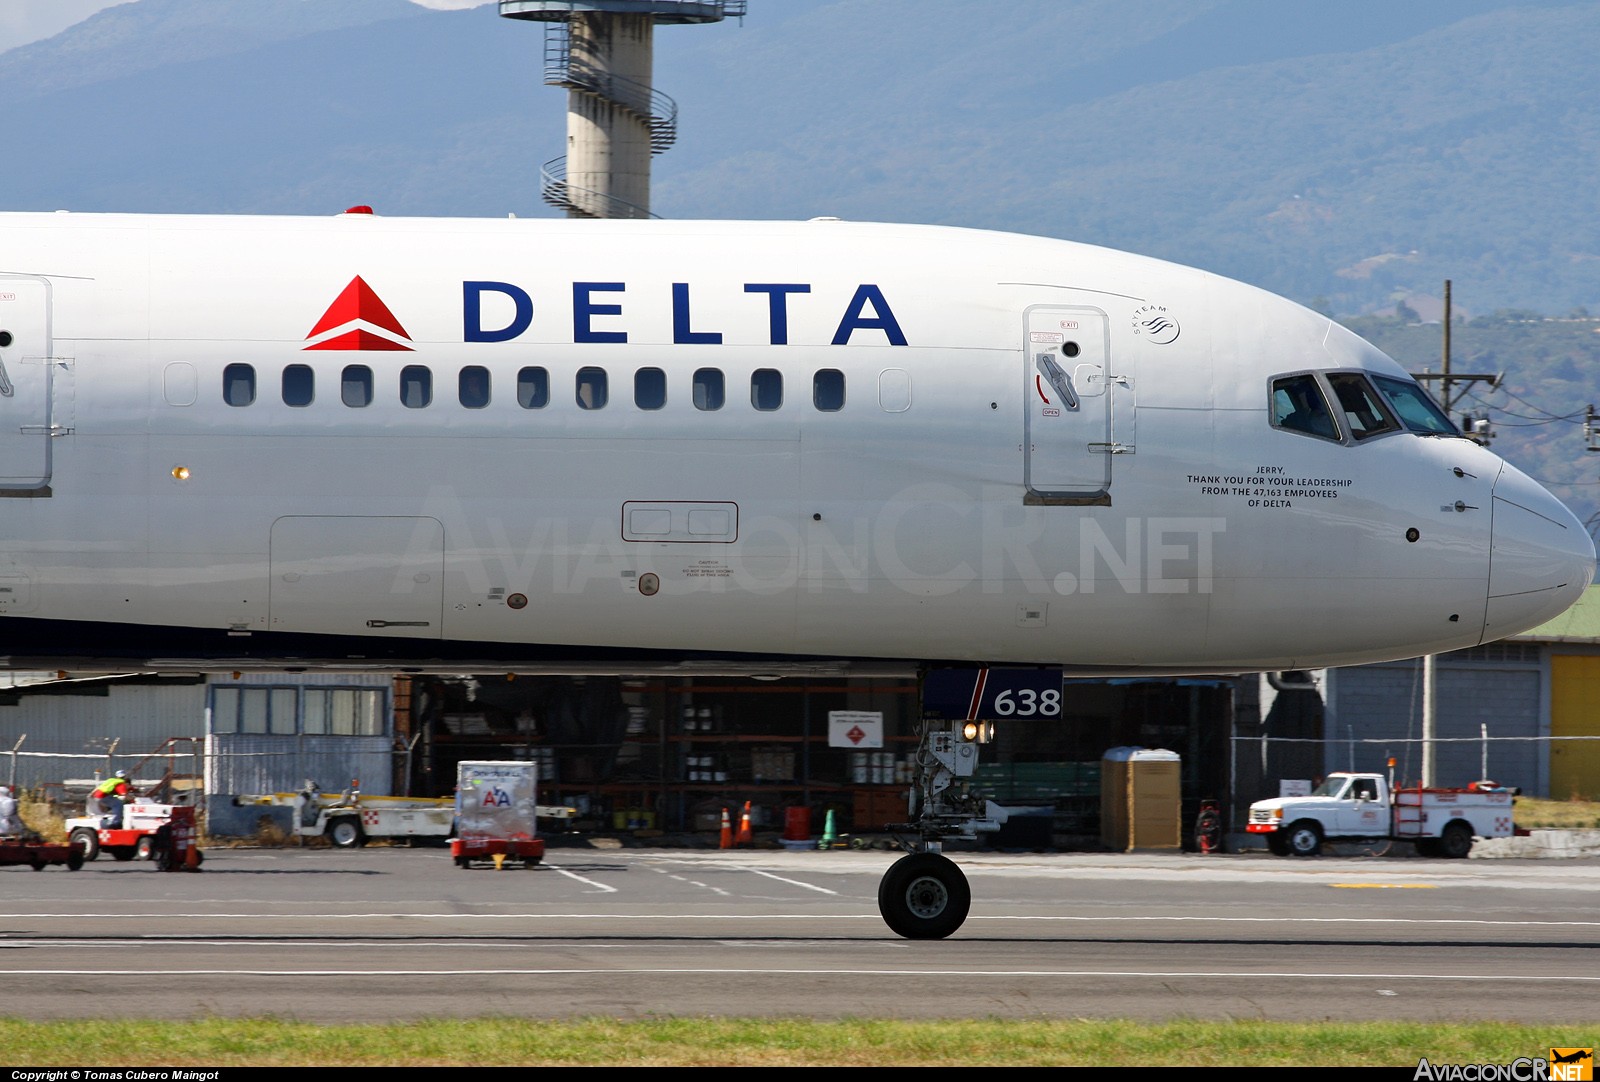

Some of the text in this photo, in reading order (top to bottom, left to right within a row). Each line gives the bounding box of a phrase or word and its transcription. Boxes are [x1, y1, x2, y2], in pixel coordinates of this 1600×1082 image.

[463, 281, 909, 346] DELTA
[1131, 305, 1167, 335] SKYTEAM
[1256, 467, 1285, 475] JERRY,
[1187, 475, 1220, 483] THANK
[1247, 477, 1264, 485] FOR
[1268, 478, 1294, 486] YOUR
[1297, 478, 1353, 487] LEADERSHIP
[1201, 487, 1228, 495] FROM
[1254, 488, 1281, 497] 47,163
[1285, 490, 1337, 498] EMPLOYEES
[1248, 499, 1292, 508] OF DELTA
[994, 688, 1061, 716] 638
[482, 788, 511, 807] AA
